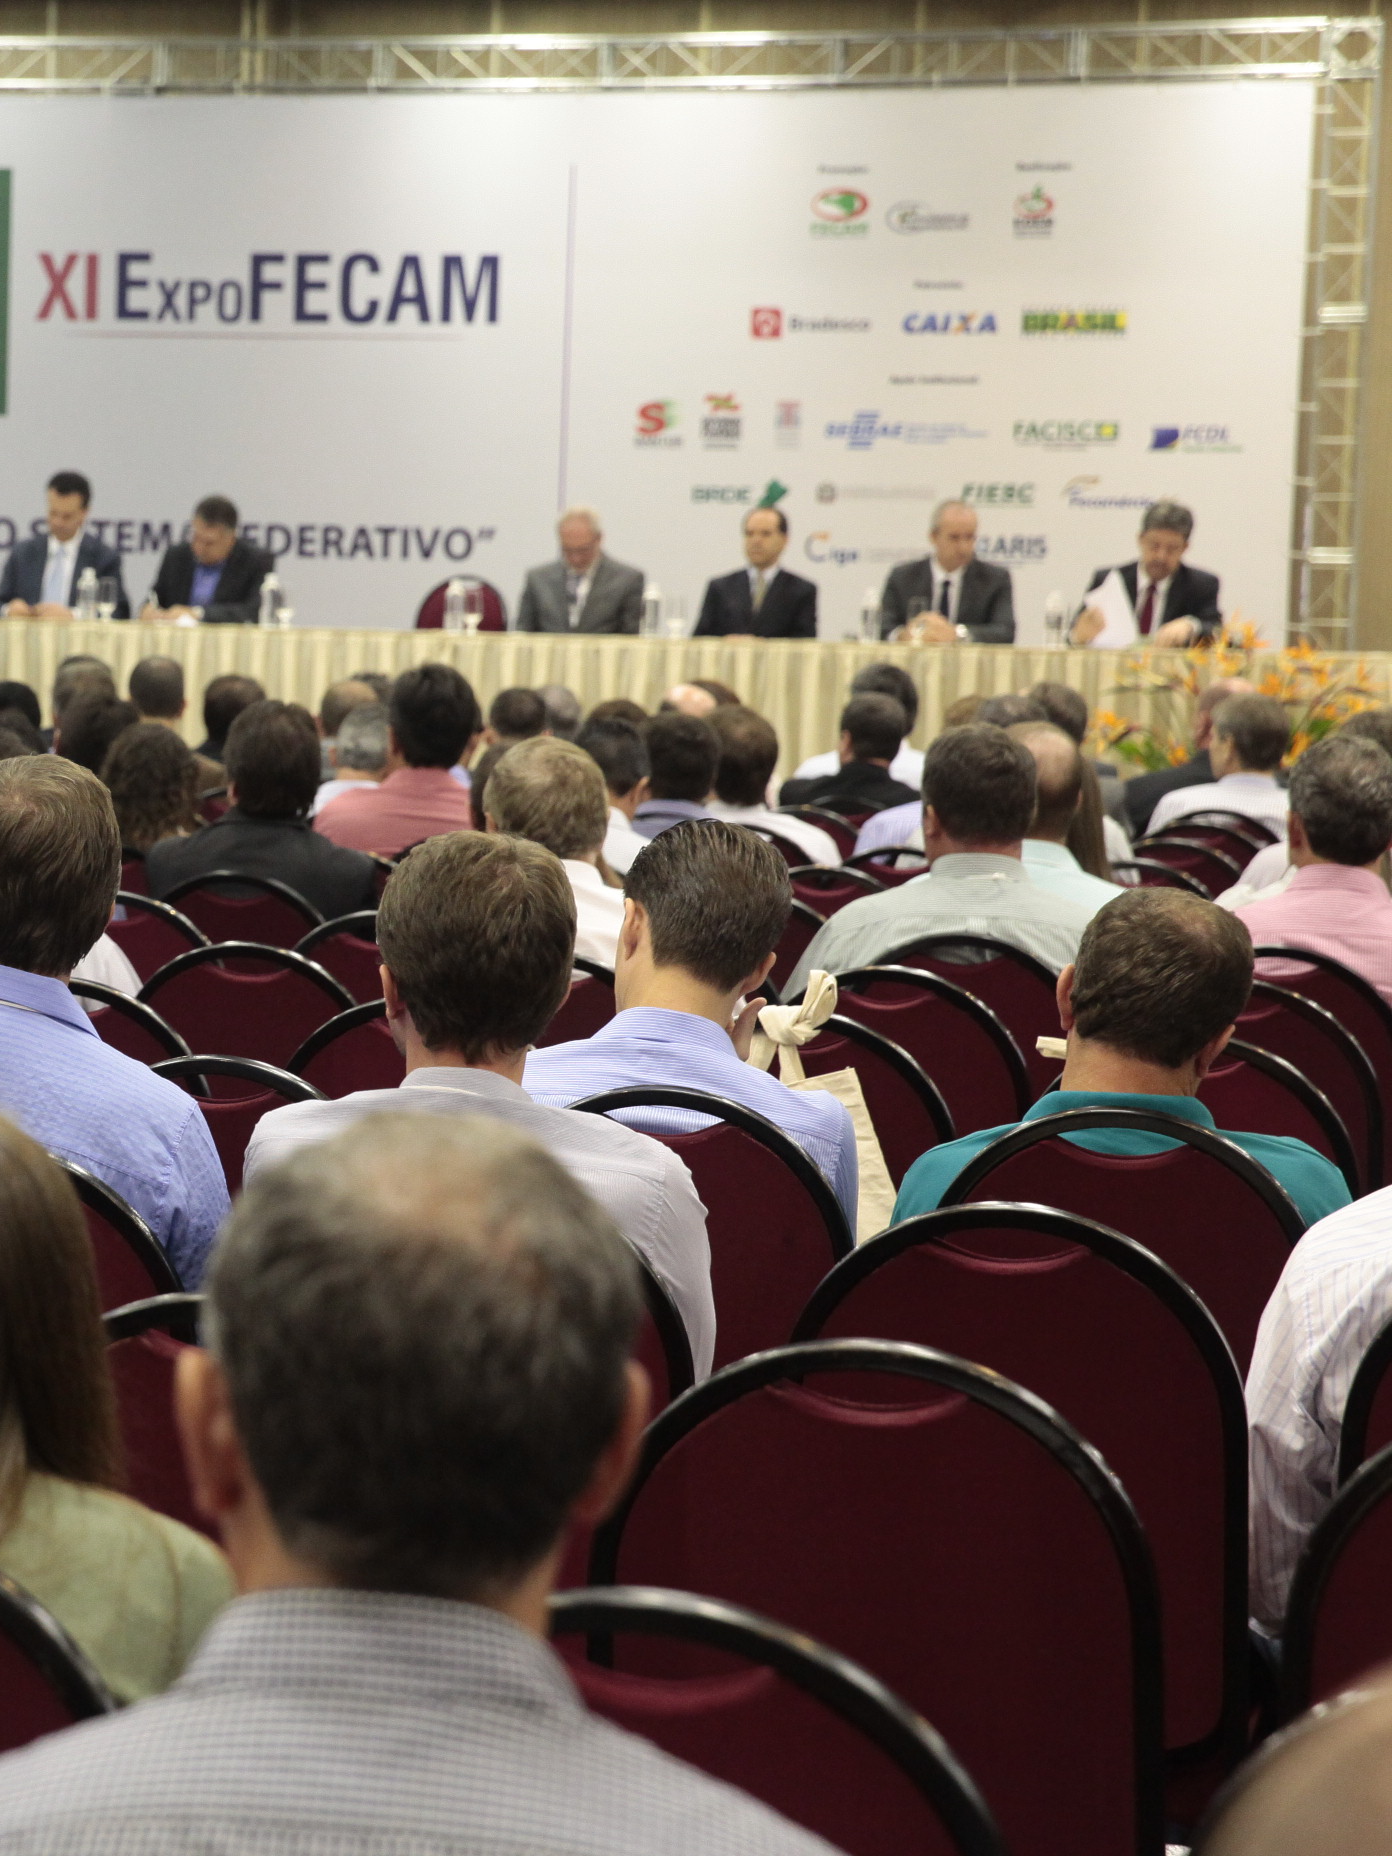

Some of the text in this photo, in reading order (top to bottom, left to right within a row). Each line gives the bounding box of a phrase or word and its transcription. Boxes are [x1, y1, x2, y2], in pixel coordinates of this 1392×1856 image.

[36, 252, 99, 322] XI
[789, 318, 871, 332] Bradesco
[902, 312, 998, 335] CAIXA
[1021, 312, 1127, 331] BRASIL
[993, 535, 1046, 557] ARIS
